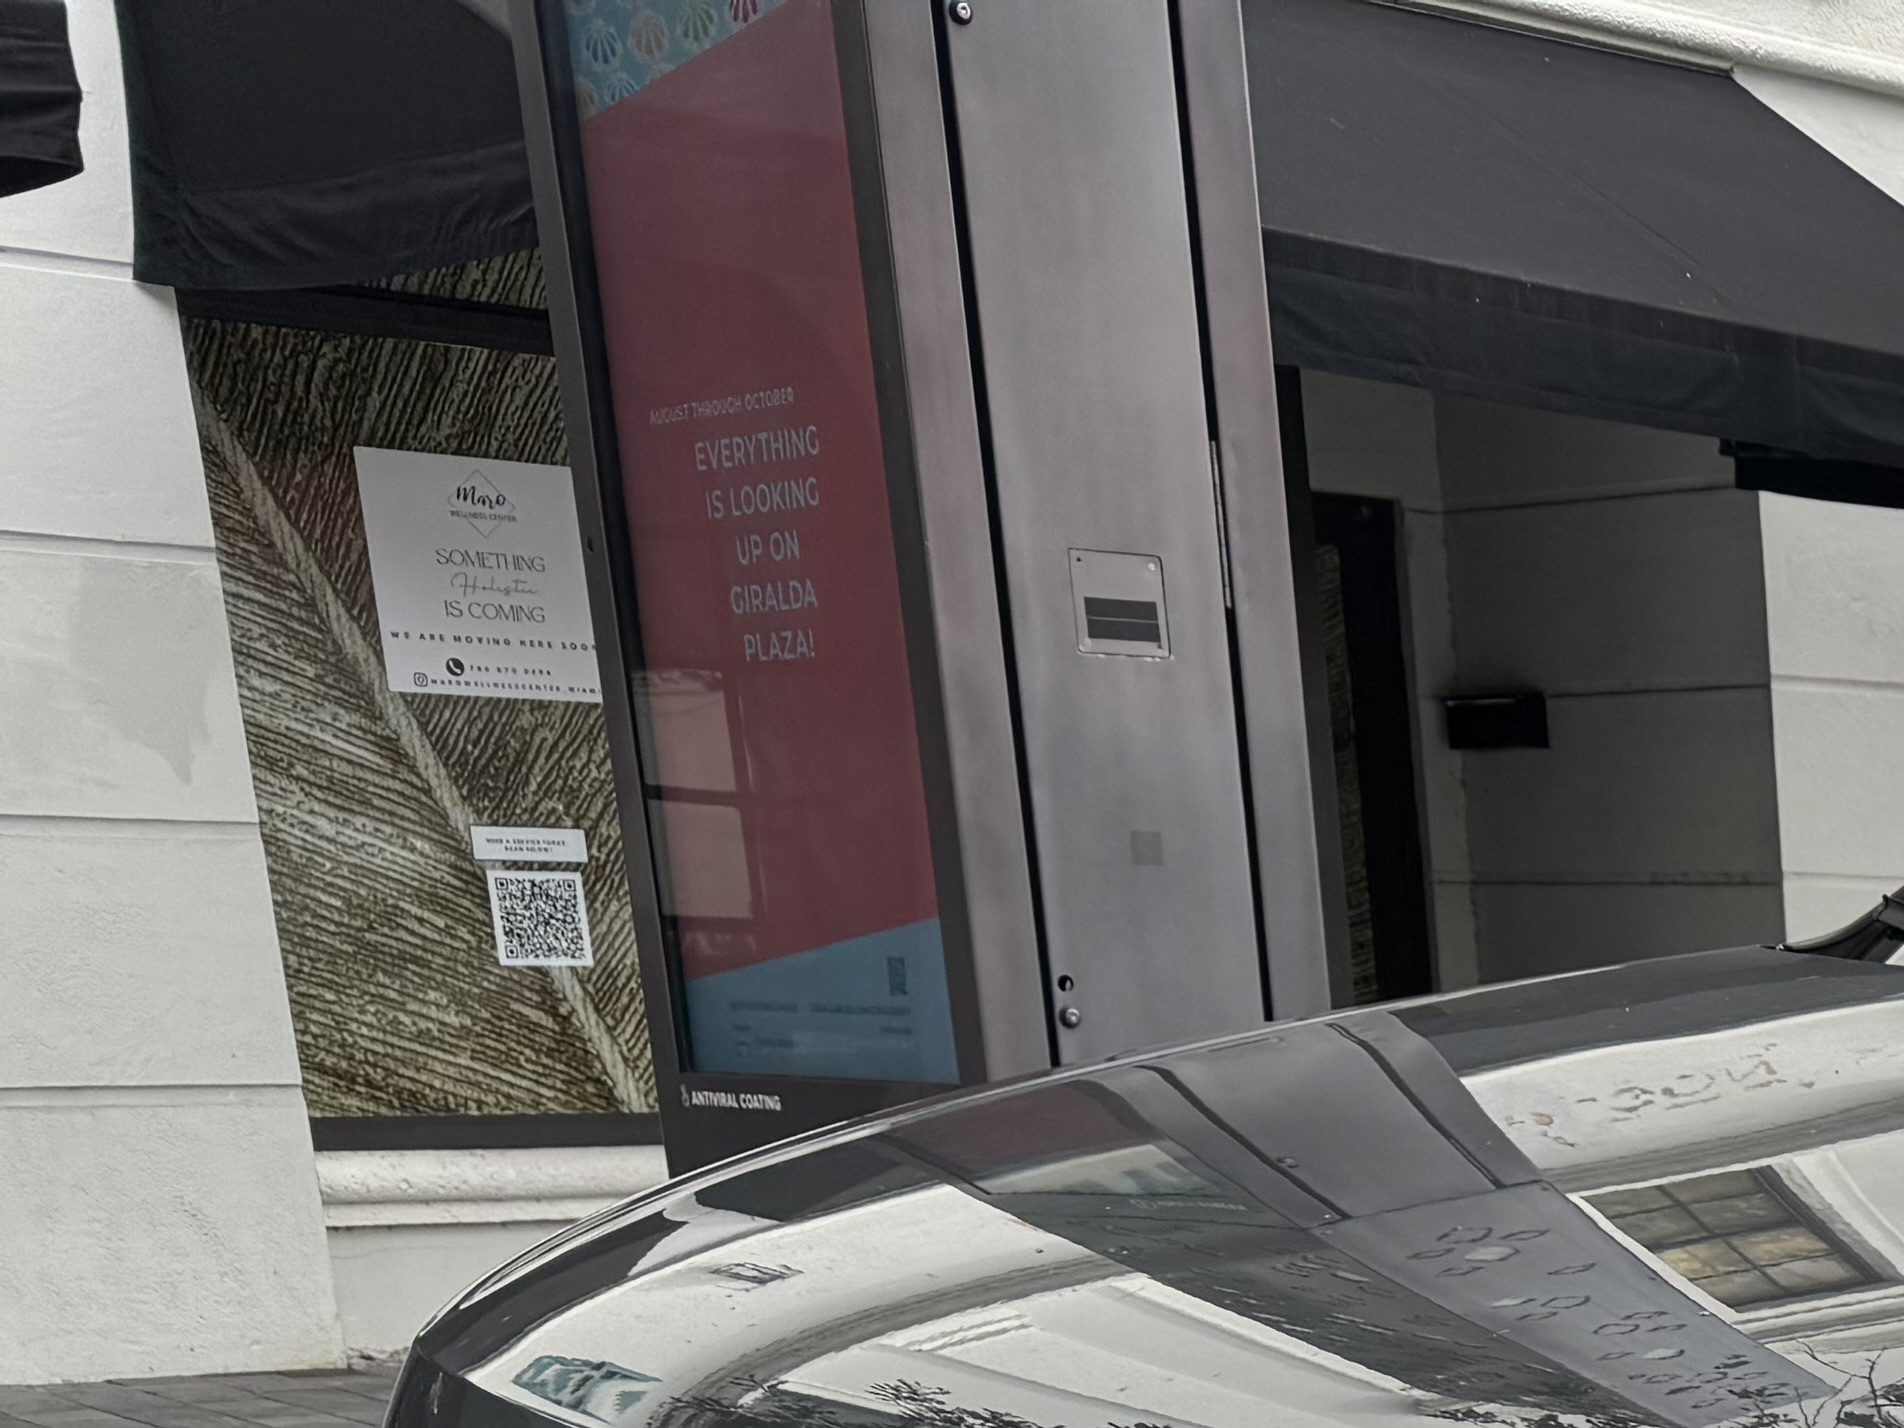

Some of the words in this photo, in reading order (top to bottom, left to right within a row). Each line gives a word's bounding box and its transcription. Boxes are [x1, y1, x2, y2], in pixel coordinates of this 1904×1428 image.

[649, 403, 690, 424] AUGUST
[744, 386, 794, 410] OCTOBER
[695, 425, 819, 471] EVERYTHING
[706, 490, 724, 519] IS
[730, 477, 819, 516] LOOKING
[435, 548, 546, 573] SOMETHING
[736, 534, 763, 565] UP
[770, 530, 800, 560] ON
[444, 600, 463, 617] IS
[468, 602, 545, 623] COMING
[730, 579, 818, 614] GIRALDA
[390, 631, 410, 640] WE
[419, 633, 445, 642] ARE
[453, 635, 511, 646] MOVING
[520, 640, 553, 649] HERE
[744, 629, 815, 661] PLAZA!
[690, 1090, 738, 1108] ANTIVIRAL
[739, 1094, 782, 1111] COATING
